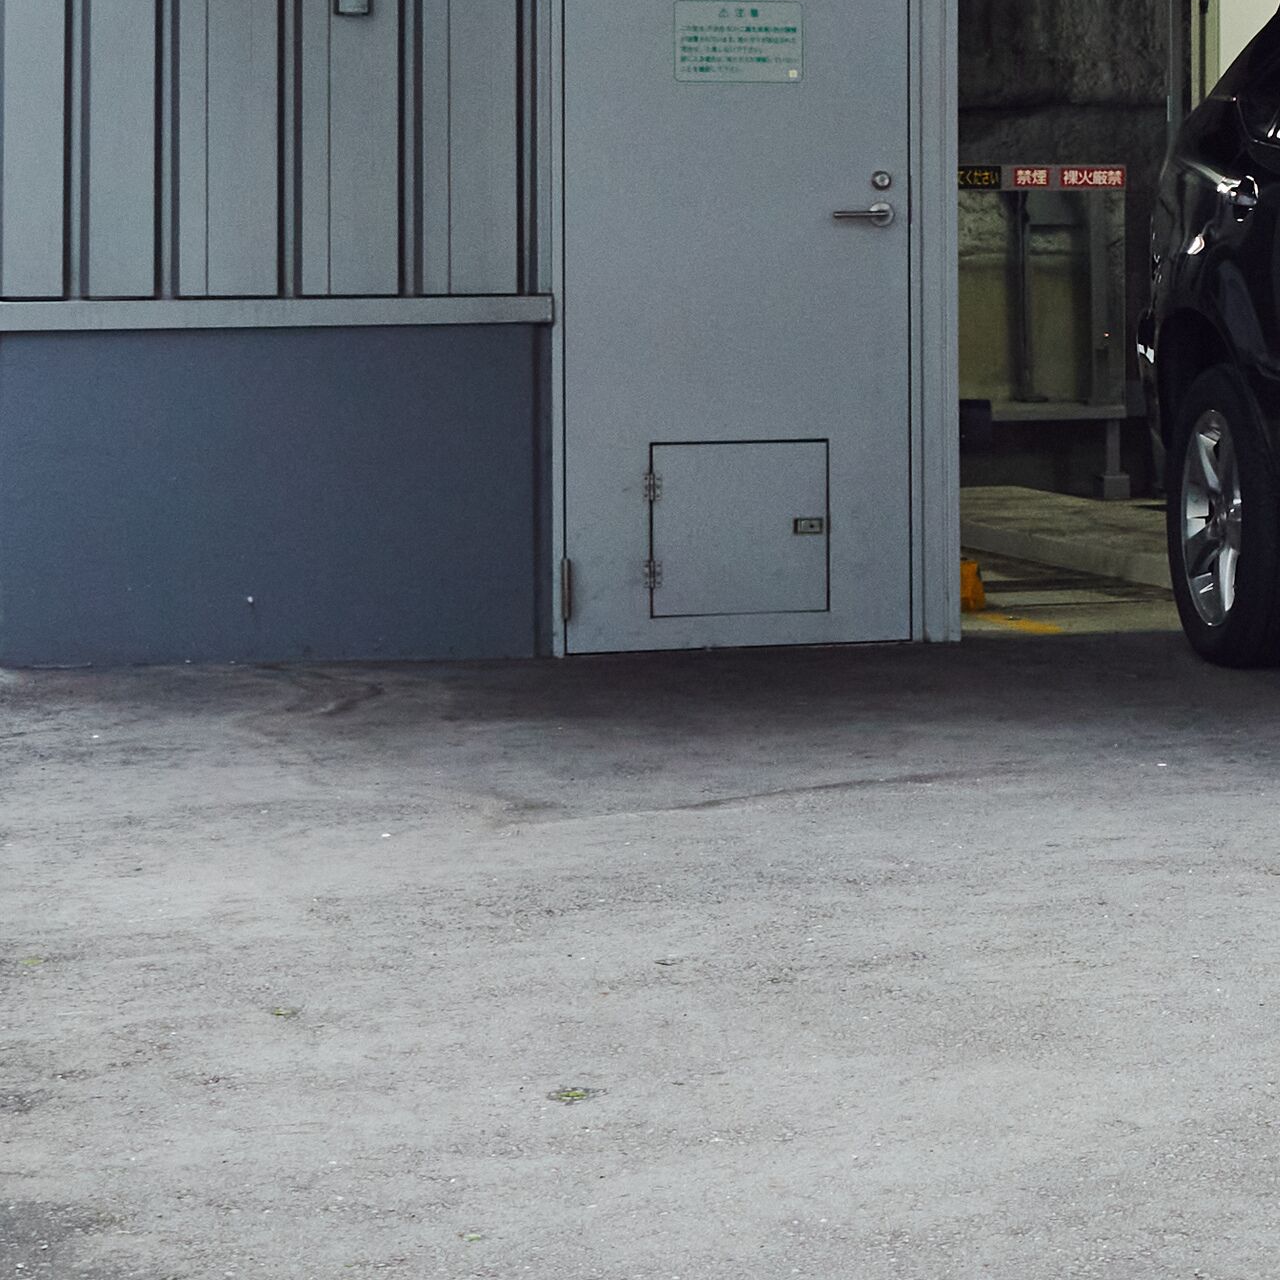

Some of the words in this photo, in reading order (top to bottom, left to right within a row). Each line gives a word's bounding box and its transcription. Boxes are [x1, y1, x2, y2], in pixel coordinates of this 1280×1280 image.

[1016, 169, 1047, 185] 禁煙
[1063, 169, 1122, 186] 裸火厳禁
